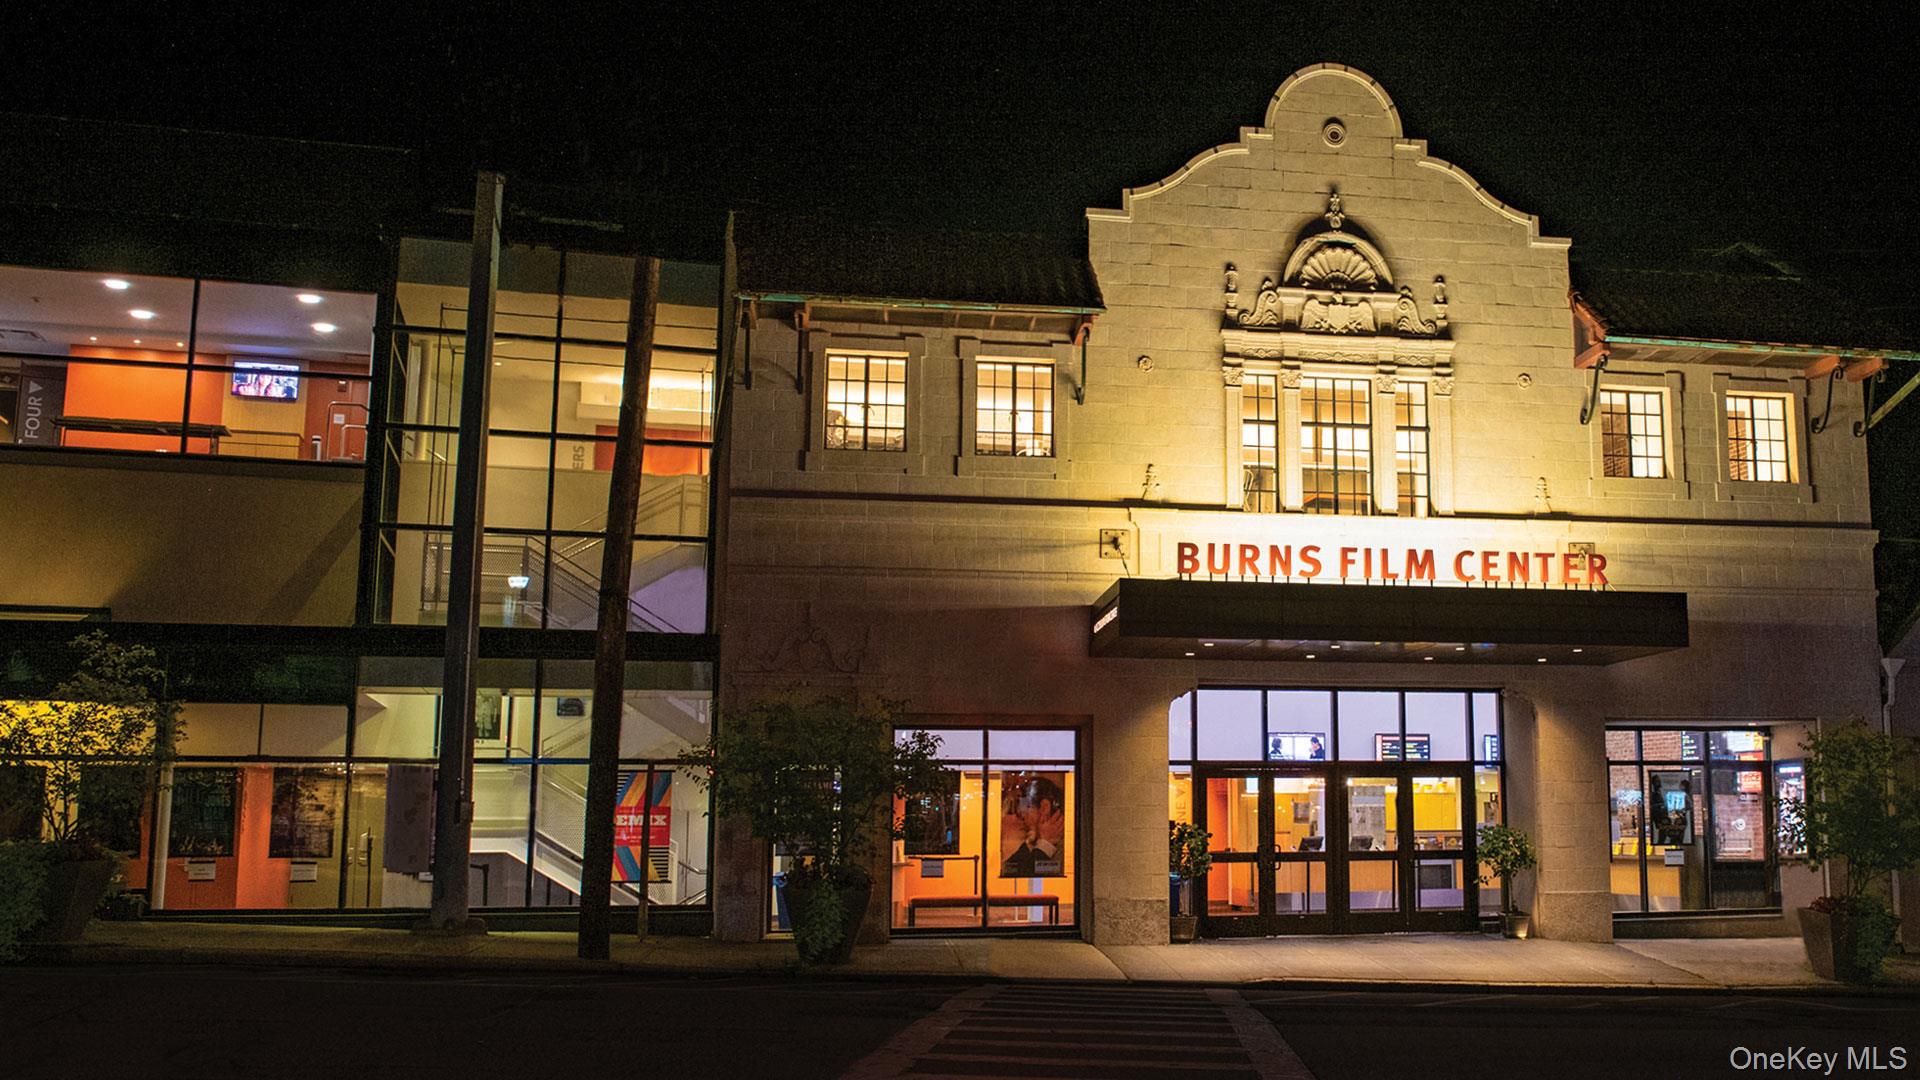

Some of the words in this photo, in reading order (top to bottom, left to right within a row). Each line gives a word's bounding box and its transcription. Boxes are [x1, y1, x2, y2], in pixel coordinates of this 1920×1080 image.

[25, 396, 42, 439] FOUR
[1178, 542, 1322, 578] BURNS
[1340, 547, 1436, 580] FILM
[1453, 550, 1609, 584] CENTER
[615, 814, 667, 826] EMIX
